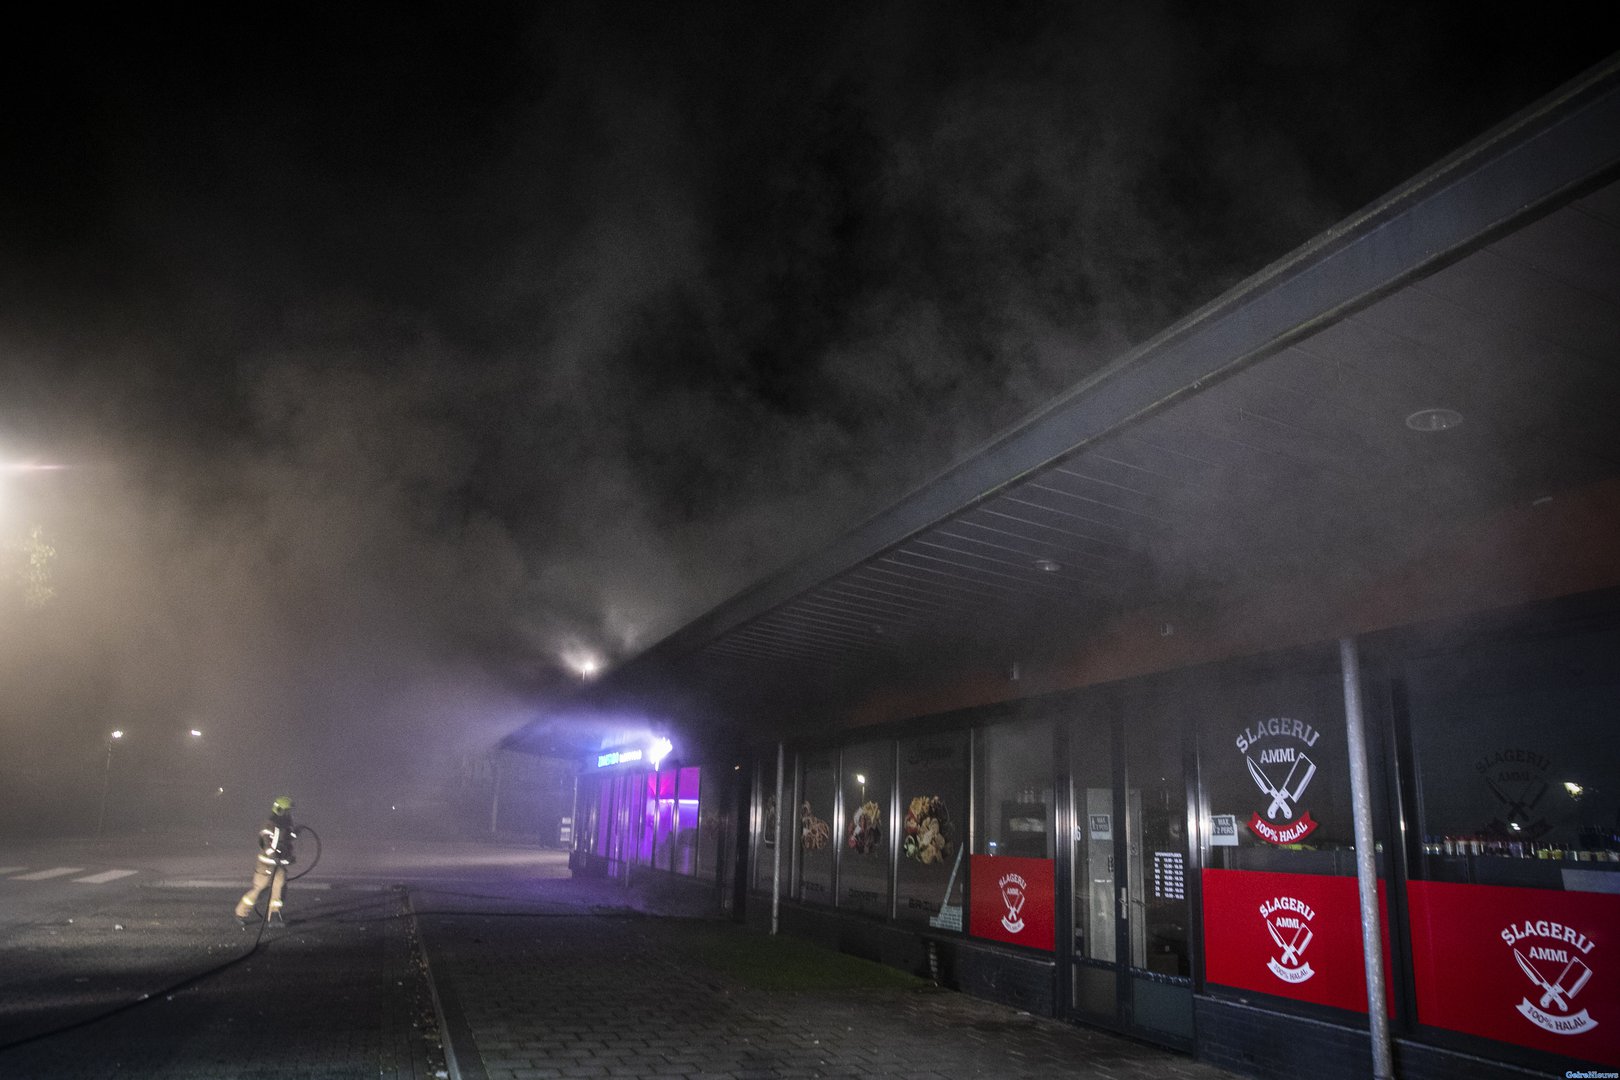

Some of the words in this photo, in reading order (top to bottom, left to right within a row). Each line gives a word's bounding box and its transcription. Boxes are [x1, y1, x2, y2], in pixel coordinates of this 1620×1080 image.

[1236, 717, 1320, 754] SLAGERIJ
[1260, 747, 1296, 764] AMMI
[1255, 819, 1278, 842] 100%
[1279, 821, 1308, 842] HALAL
[998, 873, 1027, 890] SLAGERIJ
[1259, 896, 1316, 922] SLAGERIJ
[1276, 916, 1300, 929] AMMI
[1500, 920, 1596, 955] SLAGERIJ
[1529, 945, 1569, 963] AMMI
[1289, 968, 1308, 981] HALAL
[1527, 1006, 1554, 1028] 100%
[1554, 1016, 1587, 1031] HALAL
